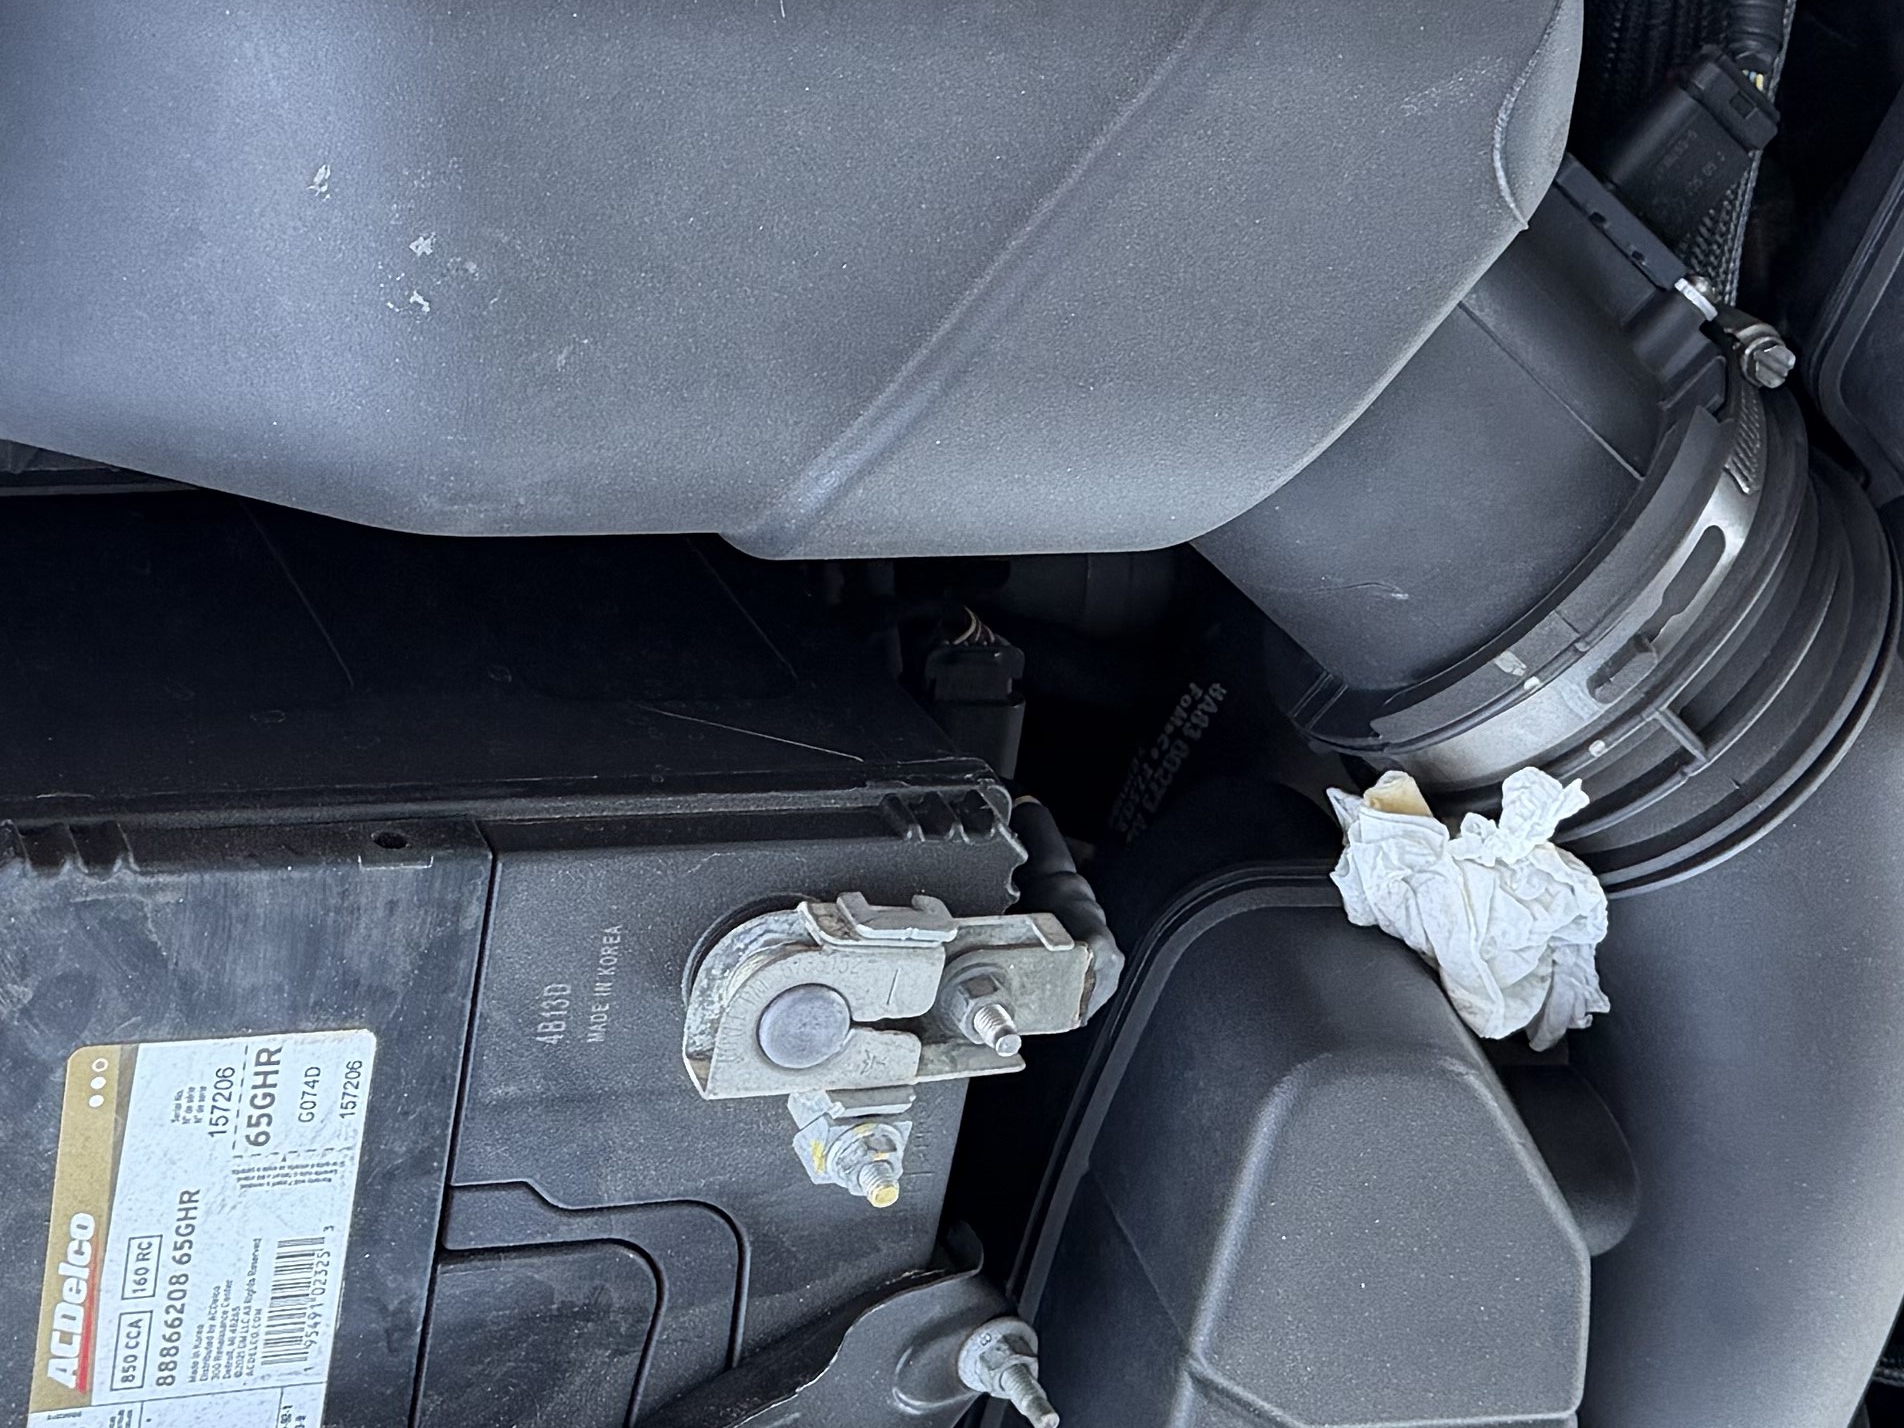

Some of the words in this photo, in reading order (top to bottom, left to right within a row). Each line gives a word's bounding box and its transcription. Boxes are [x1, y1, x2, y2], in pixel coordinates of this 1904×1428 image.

[595, 924, 621, 974] KOREA
[593, 982, 613, 995] IN
[534, 983, 571, 1043] 4B13D
[587, 1003, 610, 1042] MADE
[206, 1065, 235, 1137] 157206
[243, 1046, 282, 1147] 65GHR
[297, 1065, 321, 1123] G074D
[338, 1059, 362, 1118] 157206
[170, 1188, 200, 1265] 65GHR
[135, 1240, 153, 1262] RC
[310, 1250, 331, 1295] 02325
[47, 1211, 95, 1390] ACDelco
[131, 1266, 149, 1294] 160
[124, 1318, 142, 1349] CCA
[154, 1272, 189, 1387] 88866208
[192, 1324, 204, 1349] Korea
[303, 1303, 324, 1348] 95491
[119, 1353, 138, 1383] 850
